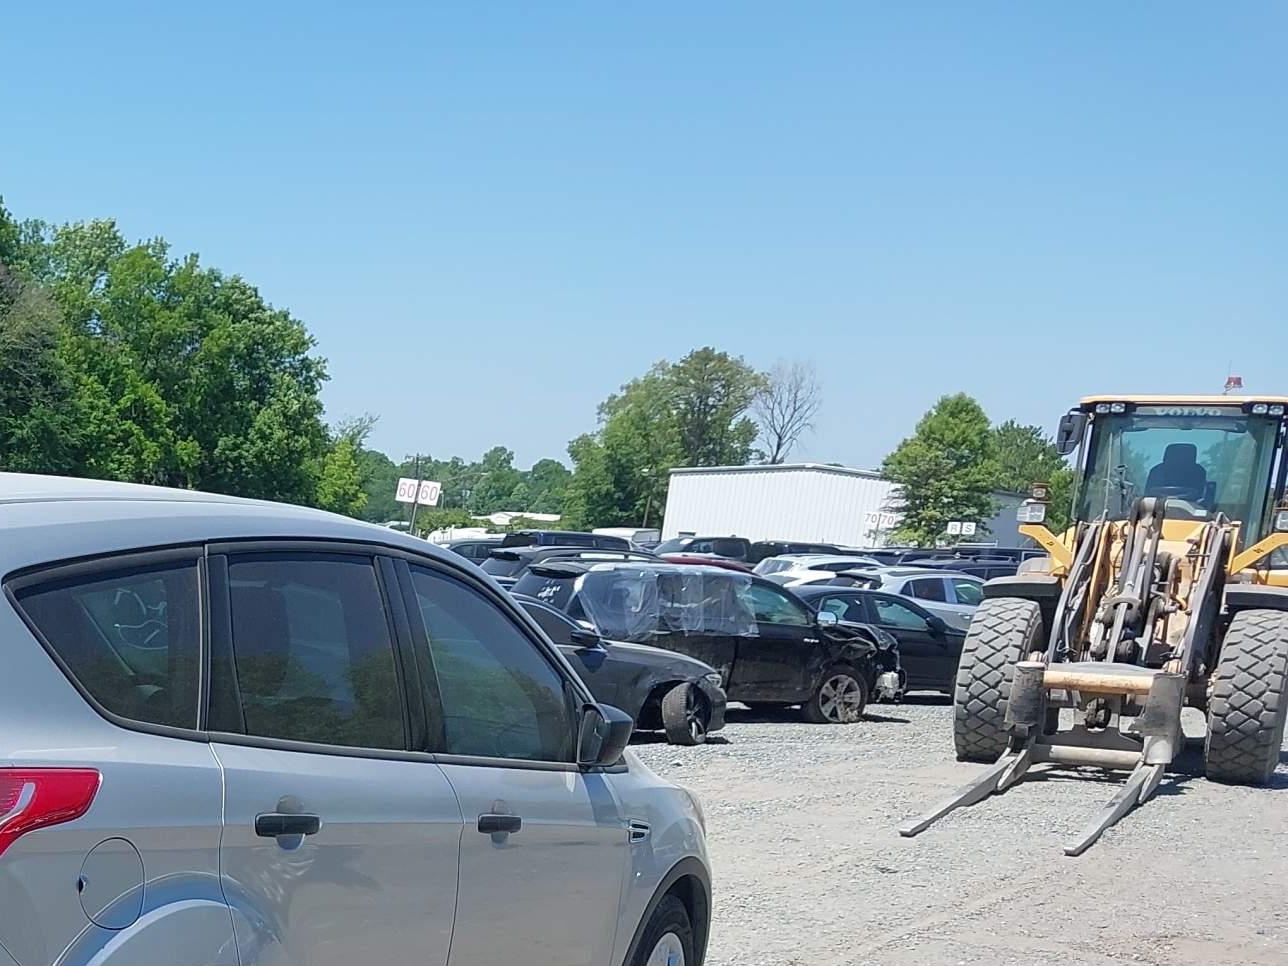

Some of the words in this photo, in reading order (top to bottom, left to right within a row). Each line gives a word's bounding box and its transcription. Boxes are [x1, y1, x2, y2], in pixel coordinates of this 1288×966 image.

[1154, 407, 1222, 417] VOLVO
[398, 482, 416, 499] 60
[420, 484, 439, 502] 60
[864, 513, 878, 524] 70
[881, 514, 894, 526] 70
[964, 524, 972, 533] S
